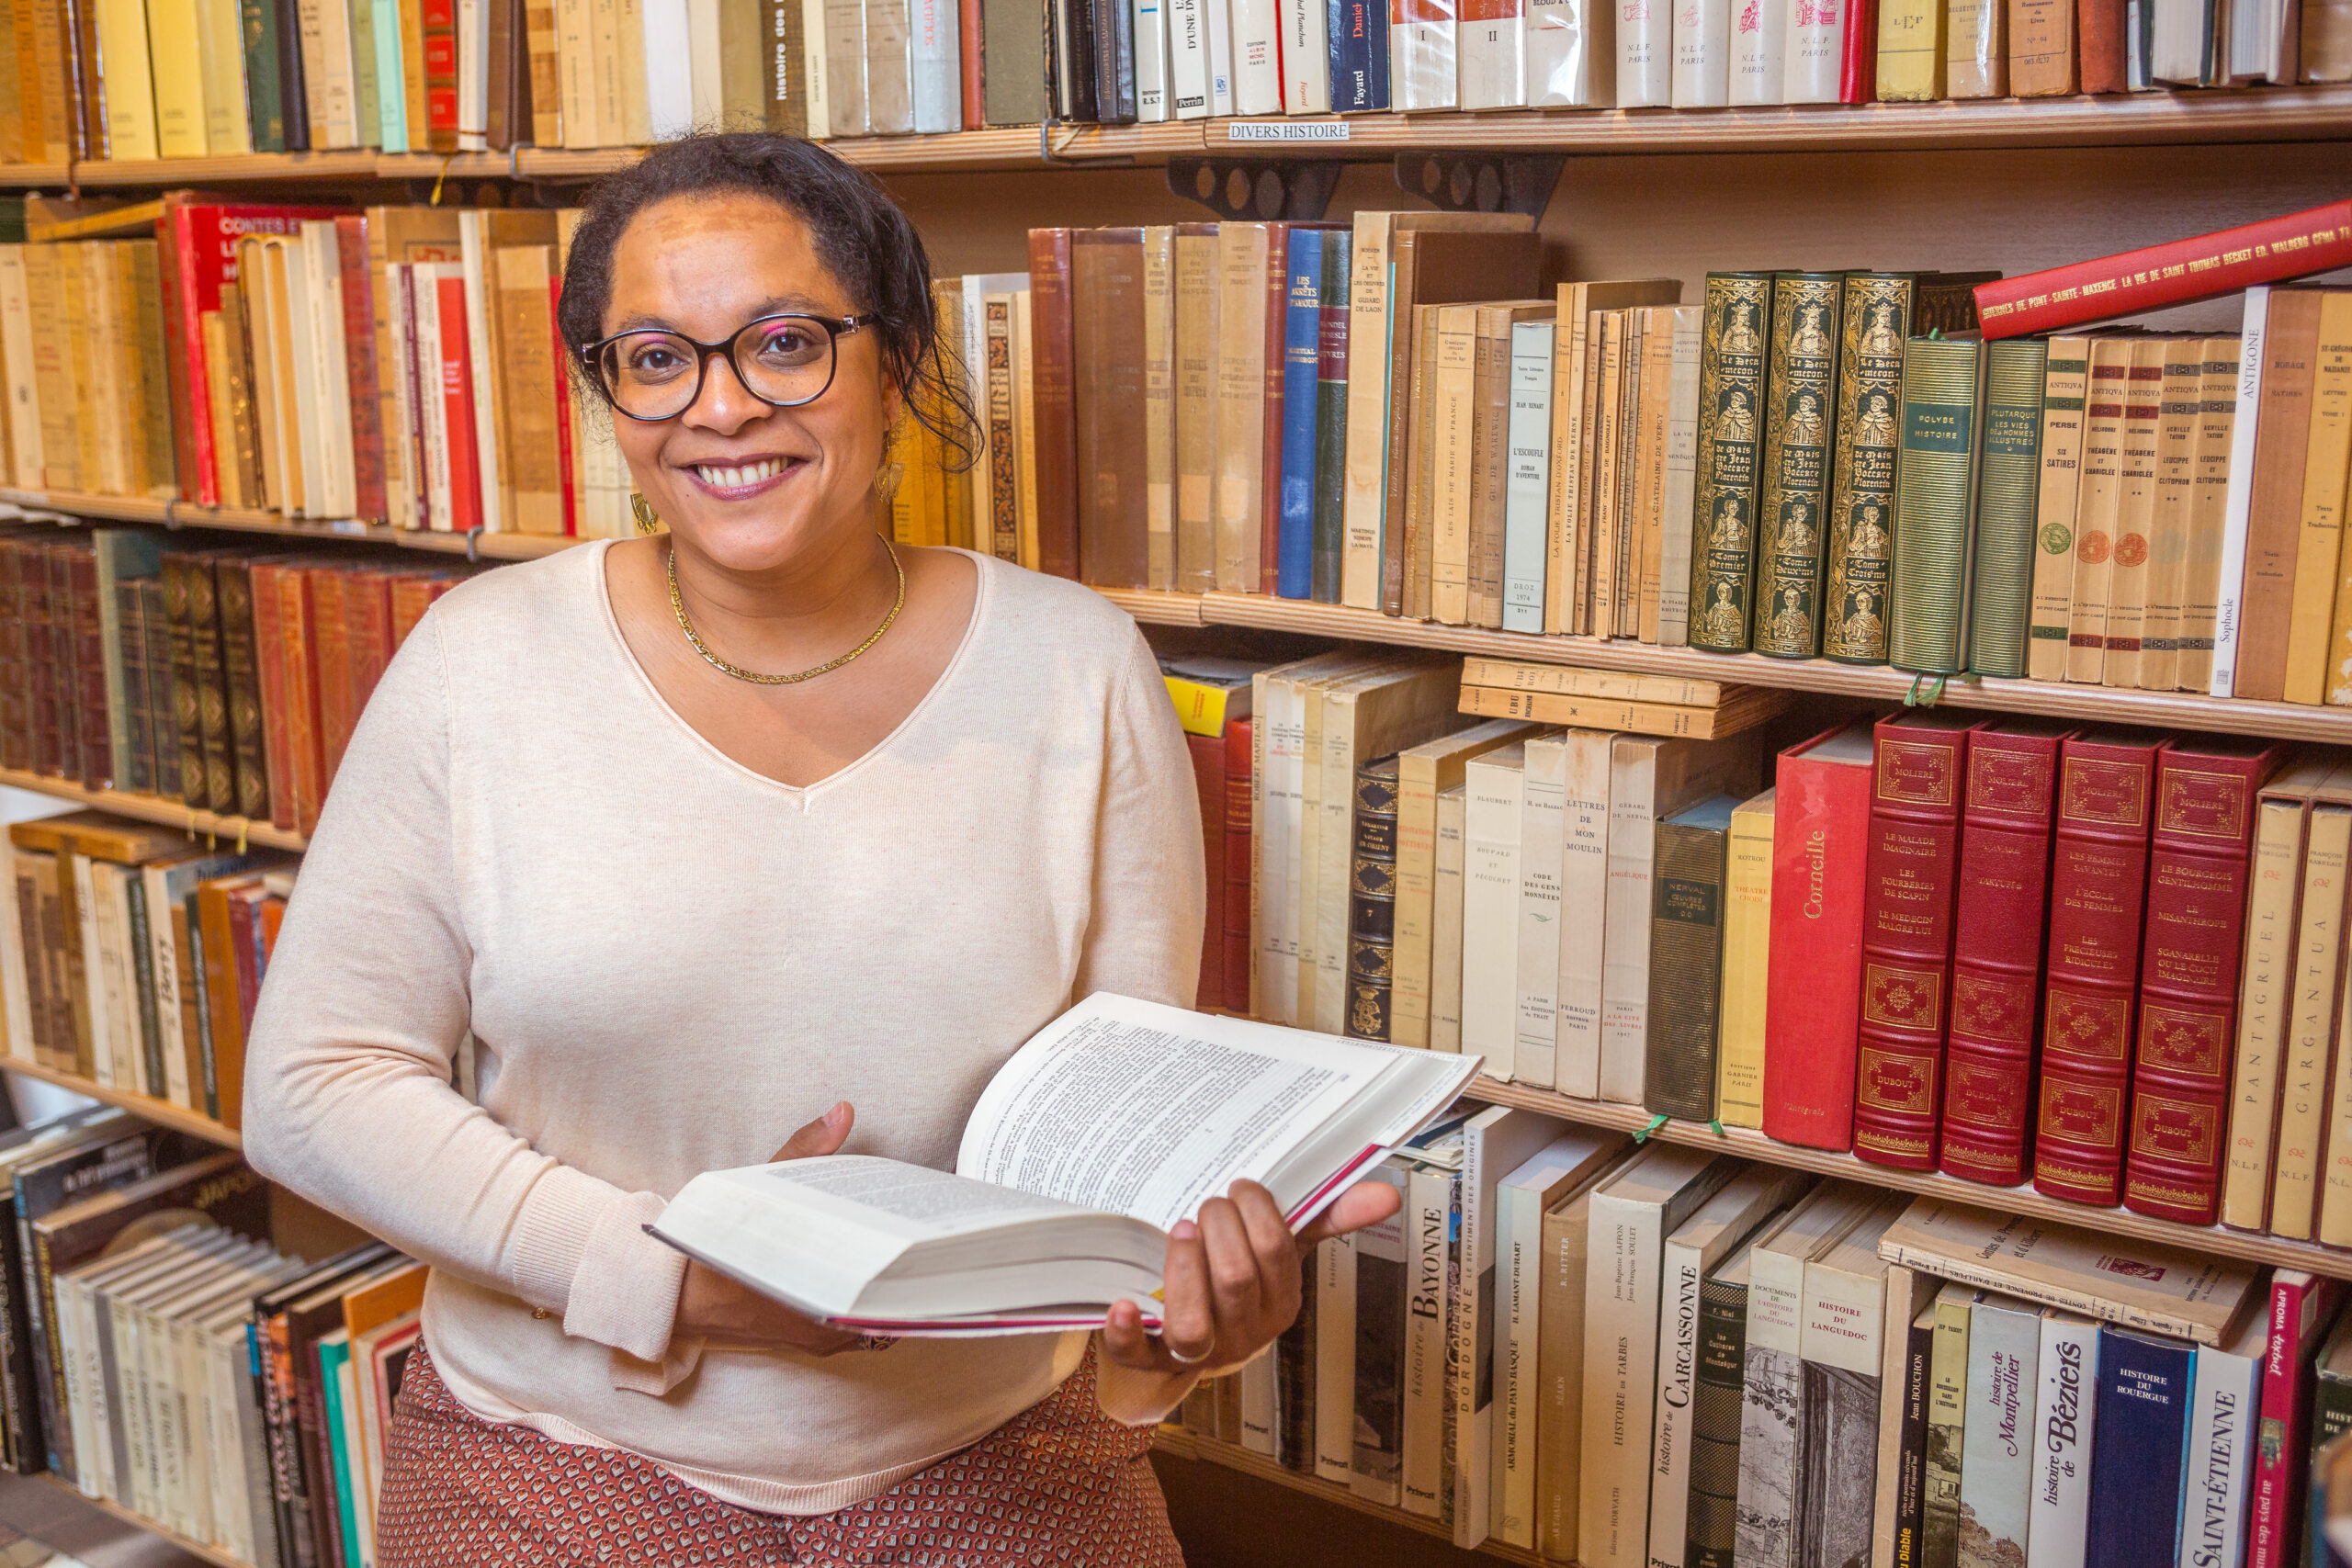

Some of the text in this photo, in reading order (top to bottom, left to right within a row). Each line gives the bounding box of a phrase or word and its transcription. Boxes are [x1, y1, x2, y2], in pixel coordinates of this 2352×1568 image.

[1352, 4, 1363, 38] Daniel
[1187, 14, 1197, 50] D'UNE
[1296, 15, 1306, 47] Planchon
[1488, 30, 1498, 42] II
[775, 14, 786, 101] histoire des
[1801, 49, 1828, 57] PARIS
[1680, 57, 1705, 65] PARIS
[1353, 70, 1365, 105] Fayard
[1177, 97, 1204, 108] Perrin
[1231, 124, 1348, 139] DIVERS HISTOIRE
[2121, 276, 2132, 288] LA
[2133, 272, 2146, 286] VIE
[2150, 269, 2161, 282] DE
[2162, 264, 2185, 278] SAINT
[2188, 255, 2220, 274] THOMAS
[2223, 248, 2252, 265] BECKET
[1296, 276, 1310, 285] LES
[2243, 329, 2259, 399] ANTIGONE
[2049, 381, 2083, 389] ANTIQVA
[2091, 388, 2123, 396] ANTIQVA
[2164, 385, 2199, 393] ANTIQVA
[2202, 384, 2236, 392] ANTIQVA
[2128, 389, 2160, 397] ANTIQVA
[1918, 415, 1955, 424] POLYBE
[1991, 410, 2036, 420] PLUTARQUE
[1915, 430, 1958, 439] HISTOIRE
[1989, 437, 2034, 446] ILLUSTRES
[1513, 447, 1544, 458] L'ESCOUFLE
[2046, 459, 2076, 469] SATIRES
[1652, 515, 1658, 528] LA
[1657, 443, 1662, 457] DE
[1554, 479, 1562, 522] TRISTAN
[1566, 532, 1572, 544] LA
[1570, 448, 1576, 463] DE
[1553, 548, 1560, 558] LA
[1513, 583, 1534, 592] DROZ
[2220, 598, 2233, 643] Sophocle
[1510, 695, 1520, 715] UBU
[1894, 768, 1935, 779] MOLIERE
[1477, 795, 1512, 807] FLAUBERT
[1566, 799, 1605, 811] LETTRES
[2180, 796, 2225, 810] MOLIERE
[1579, 815, 1592, 824] DE
[1575, 829, 1595, 839] MON
[1885, 832, 1936, 846] LE MALADE
[1566, 842, 1602, 854] MOULIN
[1883, 843, 1937, 857] IMAGINAIRE
[1532, 873, 1552, 881] CODE
[1804, 829, 1826, 919] Corneille
[1899, 868, 1915, 878] LES
[2161, 864, 2232, 881] LE BOURGEOIS
[1524, 882, 1561, 892] DES GENS
[1669, 883, 1706, 895] NERVAL
[1882, 876, 1935, 891] FOURBERIES
[2157, 875, 2233, 892] GENTILHOMME
[1524, 890, 1560, 901] HONNÊTES
[1884, 888, 1930, 901] DE SCAPIN
[2065, 897, 2123, 913] DES FEMMES
[2186, 904, 2199, 914] LE
[1879, 909, 1934, 924] LE MEDECIN
[2157, 911, 2227, 929] MISANTHROPE
[2064, 943, 2118, 959] PRECIEUSES
[2157, 947, 2220, 964] SGANARELLE
[1560, 1004, 1596, 1015] FERROUD
[2245, 910, 2274, 1104] PANTAGRUEL
[2295, 919, 2327, 1114] GARGANTUA
[1568, 1022, 1588, 1031] PARIS
[1727, 1070, 1758, 1079] GARNIER
[1732, 1079, 1753, 1088] PARIS
[1877, 1075, 1915, 1089] DUBOUT
[2059, 1106, 2098, 1120] DUBOUT
[2154, 1123, 2193, 1137] DUBOUT
[1465, 1265, 1472, 1279] LE
[1754, 1284, 1798, 1300] DOCUMENTS
[1412, 1208, 1442, 1396] histoire de BAYONNE
[1758, 1300, 1794, 1313] L'HISTOIRE
[1818, 1301, 1862, 1317] HISTOIRE
[1753, 1313, 1796, 1329] LANGUEDOC
[1833, 1314, 1847, 1325] DU
[1811, 1321, 1868, 1342] LANGUEDOC
[2267, 1288, 2287, 1377] APROMA textuel
[1461, 1287, 1472, 1412] DORDOGNE
[1657, 1265, 1697, 1476] histoire de CARCASSONNE
[2120, 1368, 2167, 1385] HISTOIRE
[1989, 1351, 2002, 1406] histoire de
[1614, 1336, 1629, 1447] HISTOIRE DE TARBES
[1910, 1353, 1923, 1421] Jean BOUCHON
[2137, 1381, 2152, 1391] DU
[2047, 1341, 2082, 1453] Béziers
[2116, 1385, 2169, 1404] ROUERGUE
[1507, 1339, 1520, 1472] ARMORIAL du PAYS BASQUE
[1998, 1354, 2020, 1458] Montpellier
[1320, 1455, 1349, 1469] Privat
[2043, 1455, 2075, 1506] histoire de
[2192, 1390, 2235, 1567] SAINT-ÉTIENNE
[1406, 1484, 1435, 1500] Privat
[2258, 1480, 2273, 1542] au pays des
[1899, 1528, 1911, 1561] Diable
